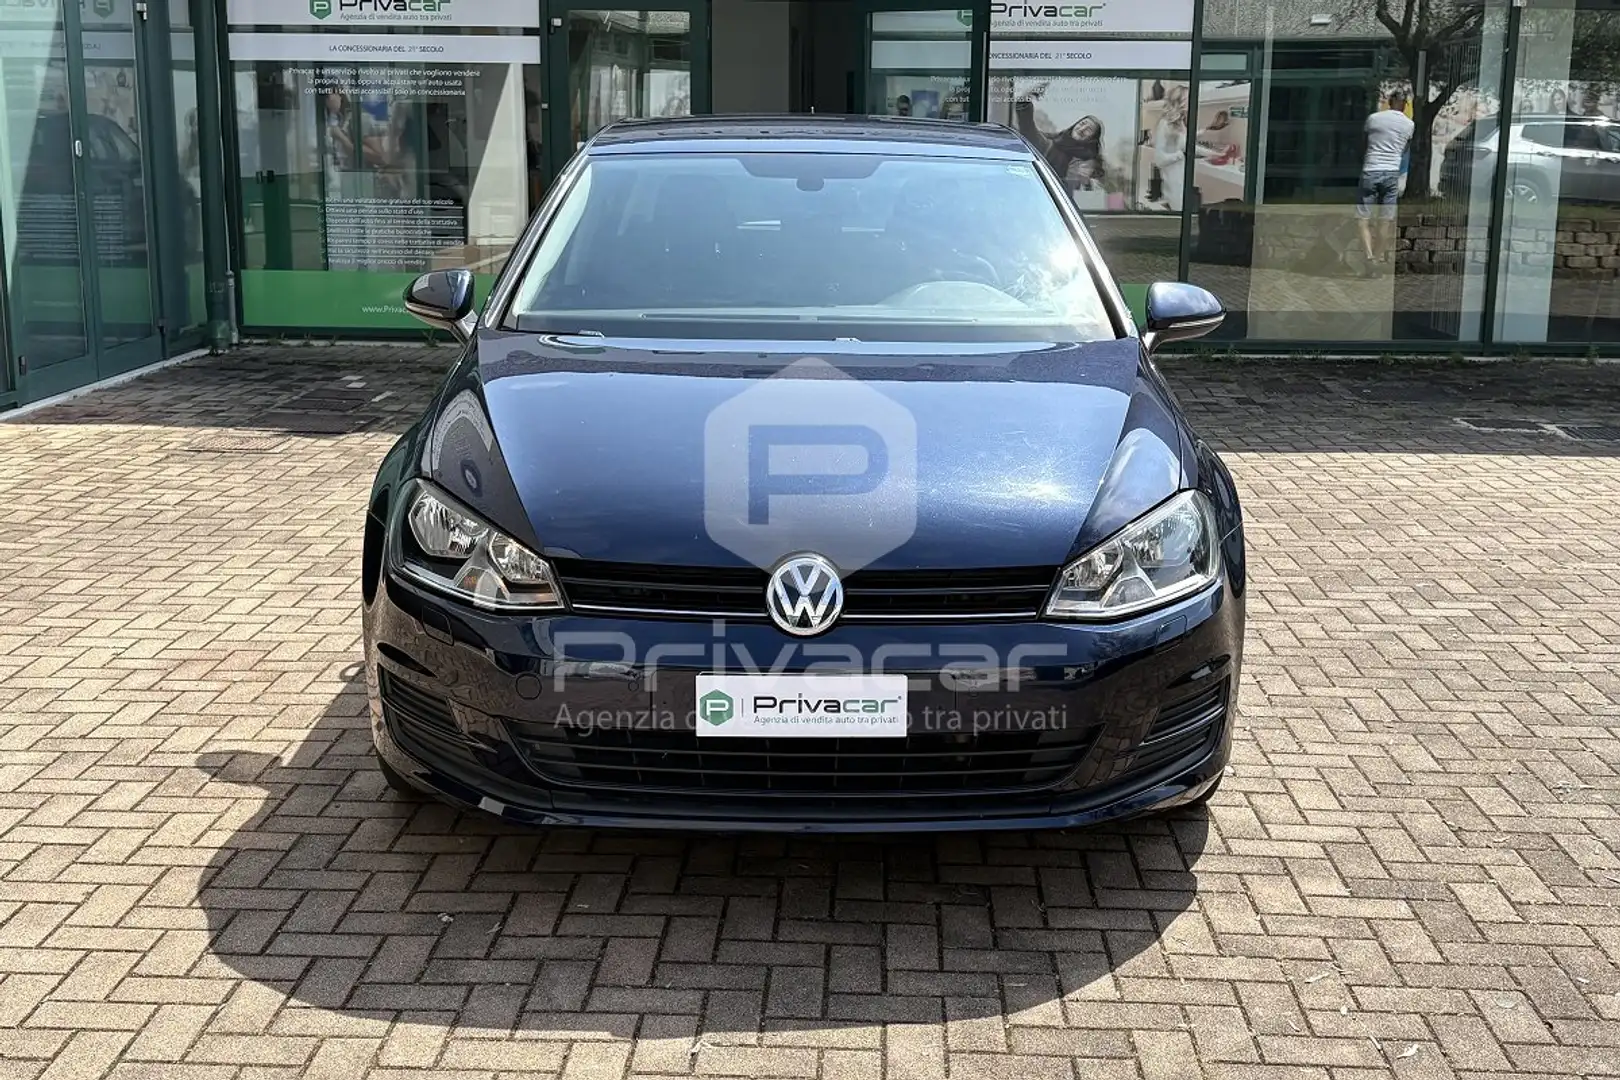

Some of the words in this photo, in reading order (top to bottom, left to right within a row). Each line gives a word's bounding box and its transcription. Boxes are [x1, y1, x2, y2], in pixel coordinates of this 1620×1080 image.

[341, 13, 367, 21] Agenzia
[368, 13, 376, 21] di
[376, 13, 401, 21] vendita
[403, 13, 418, 21] auto
[420, 13, 429, 21] tra
[430, 13, 452, 21] privati
[990, 20, 1016, 28] genzia
[1016, 20, 1025, 28] di
[1026, 20, 1051, 28] vendita
[1052, 20, 1068, 28] auto
[1069, 20, 1080, 28] tra
[1080, 20, 1103, 28] privati
[329, 45, 337, 53] LA
[338, 45, 392, 53] CONCESSIONARIA
[394, 45, 405, 53] DEL
[419, 45, 444, 53] SECOLO
[1040, 52, 1052, 60] DEL
[1066, 52, 1092, 60] SECOLO
[409, 68, 422, 76] che
[423, 69, 452, 77] vogliono
[453, 69, 481, 77] vendere
[753, 693, 899, 714] Privacar
[753, 716, 789, 725] Agenzia
[790, 716, 800, 724] di
[800, 716, 833, 724] vendita
[835, 716, 855, 724] auto
[857, 716, 869, 724] tra
[870, 716, 899, 725] privati
